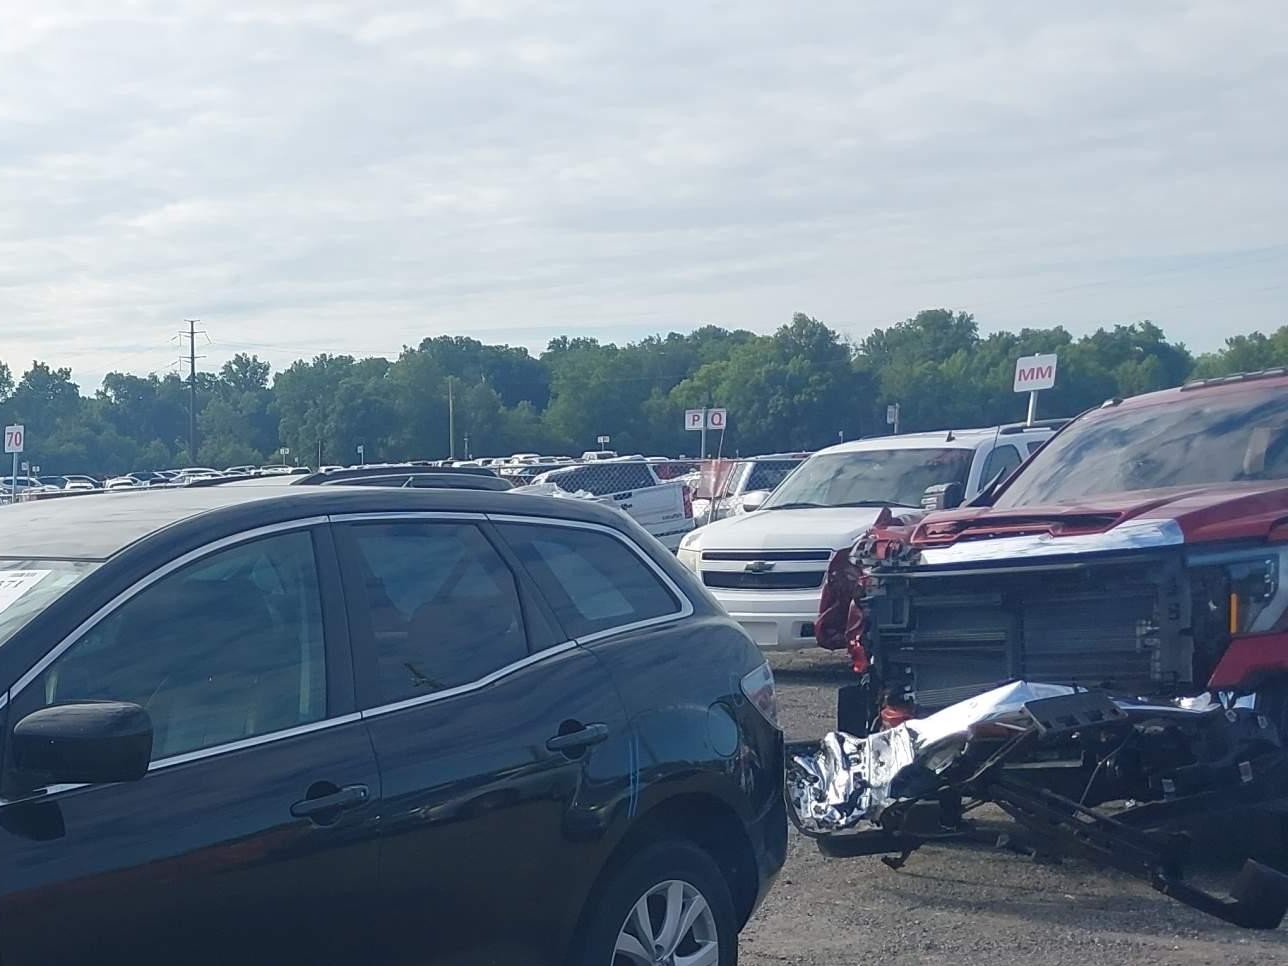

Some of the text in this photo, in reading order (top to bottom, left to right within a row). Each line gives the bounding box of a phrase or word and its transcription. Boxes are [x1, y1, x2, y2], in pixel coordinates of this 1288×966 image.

[1018, 365, 1053, 382] MM
[691, 412, 723, 426] P Q
[6, 431, 22, 447] 70
